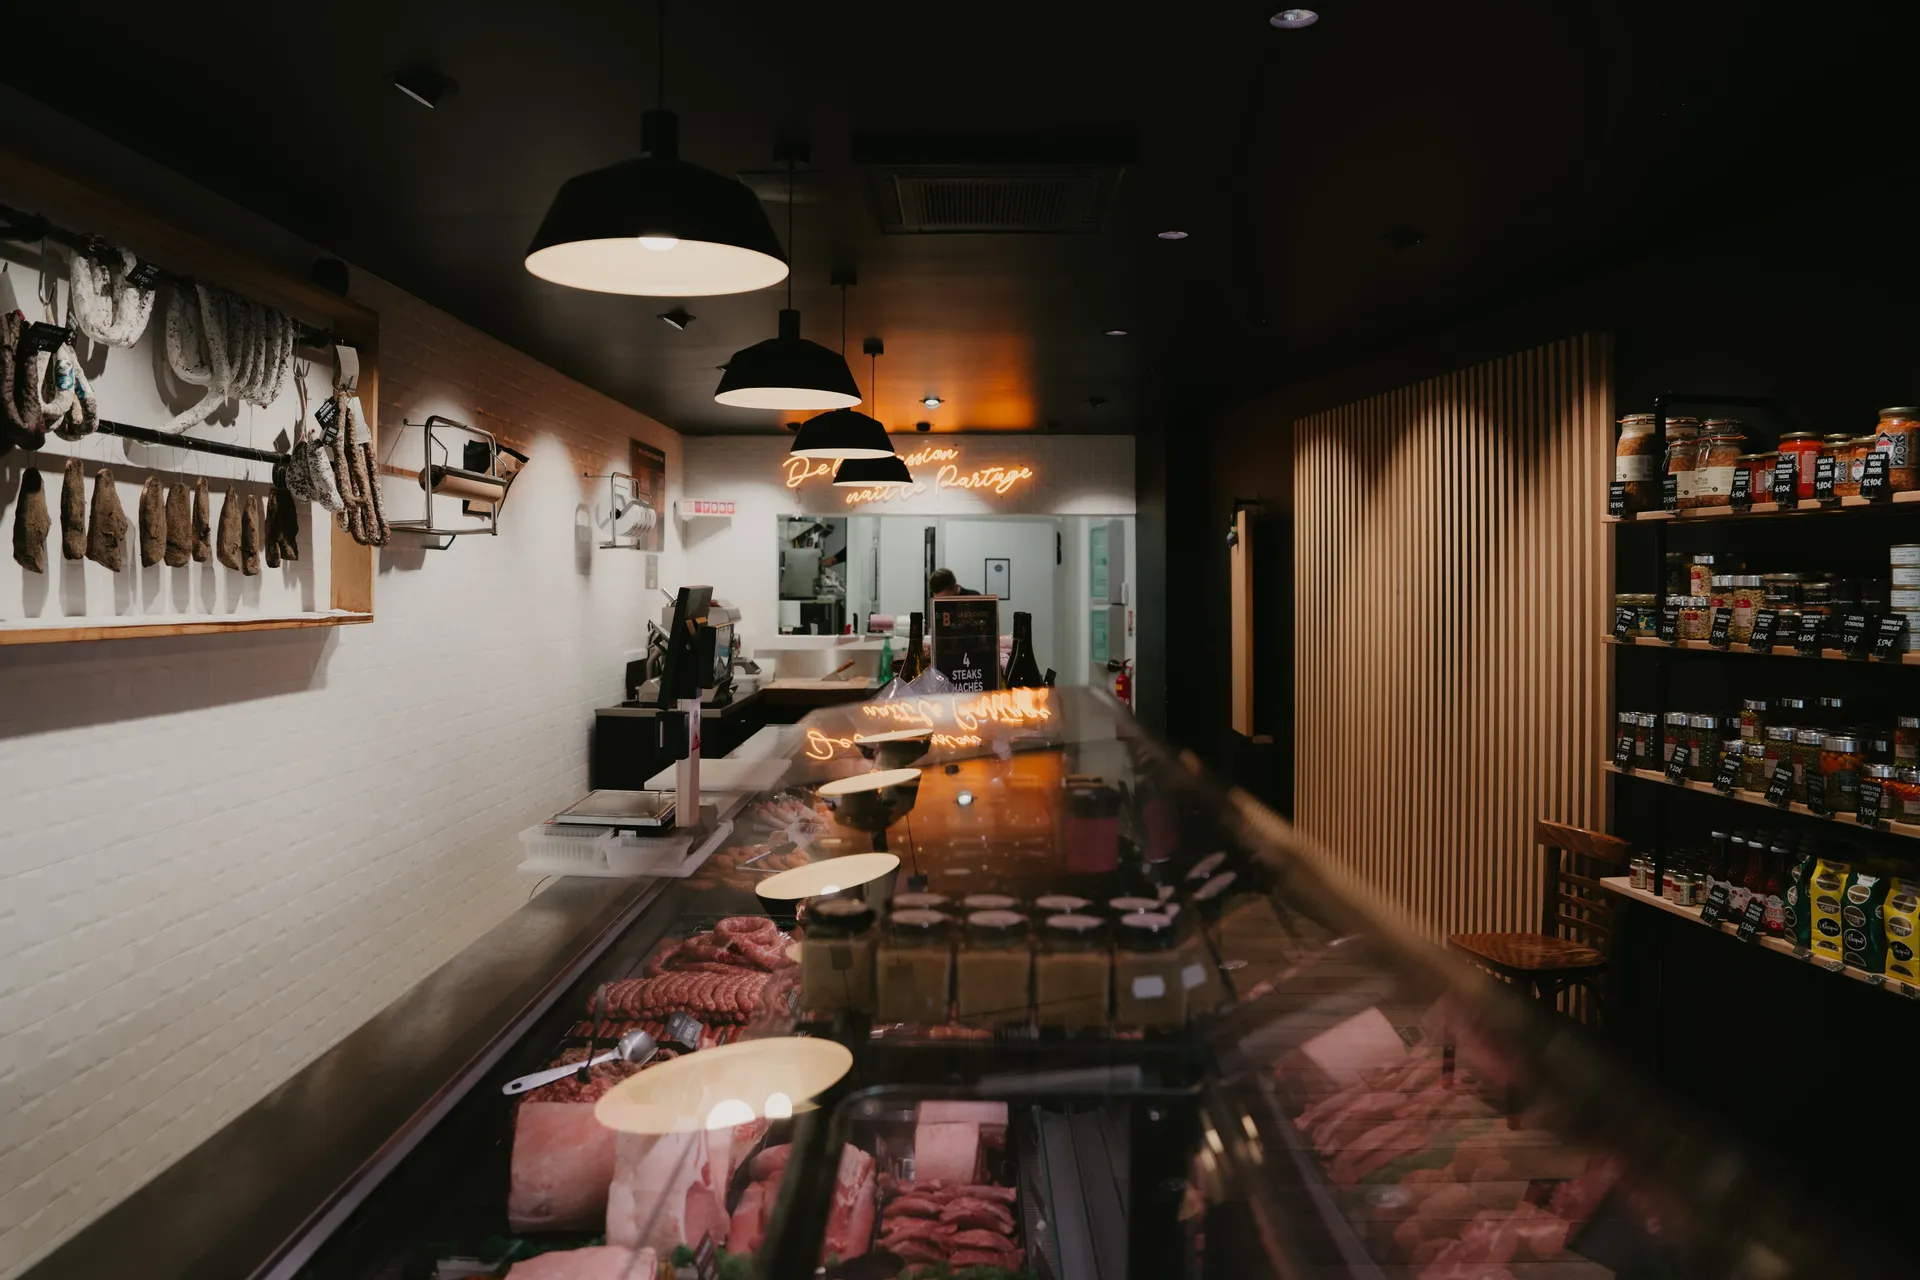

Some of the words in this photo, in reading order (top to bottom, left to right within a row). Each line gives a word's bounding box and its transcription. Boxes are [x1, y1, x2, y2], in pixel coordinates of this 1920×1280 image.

[935, 464, 1033, 494] Partage
[963, 652, 971, 668] 4
[952, 668, 983, 681] STEAKS
